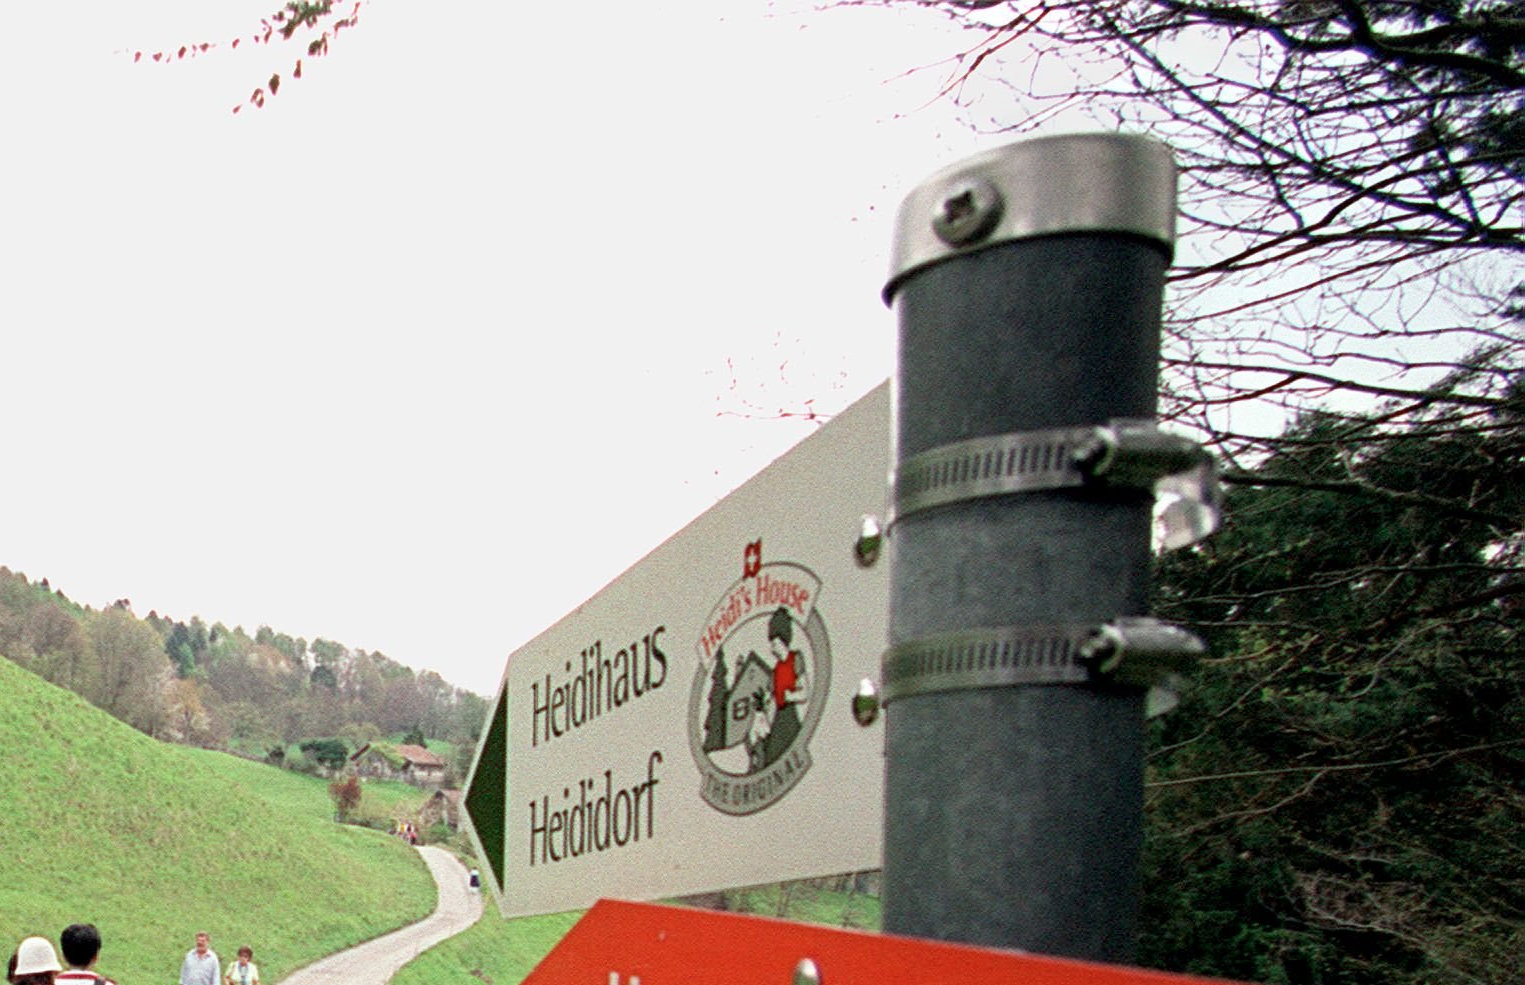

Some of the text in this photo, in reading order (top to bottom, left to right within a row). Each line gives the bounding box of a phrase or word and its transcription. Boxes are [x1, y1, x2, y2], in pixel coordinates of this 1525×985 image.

[702, 574, 810, 657] Heidi's House
[531, 625, 668, 748] Heidihaus
[529, 751, 663, 867] Heididorf
[705, 750, 804, 806] THE ORIGINAL
